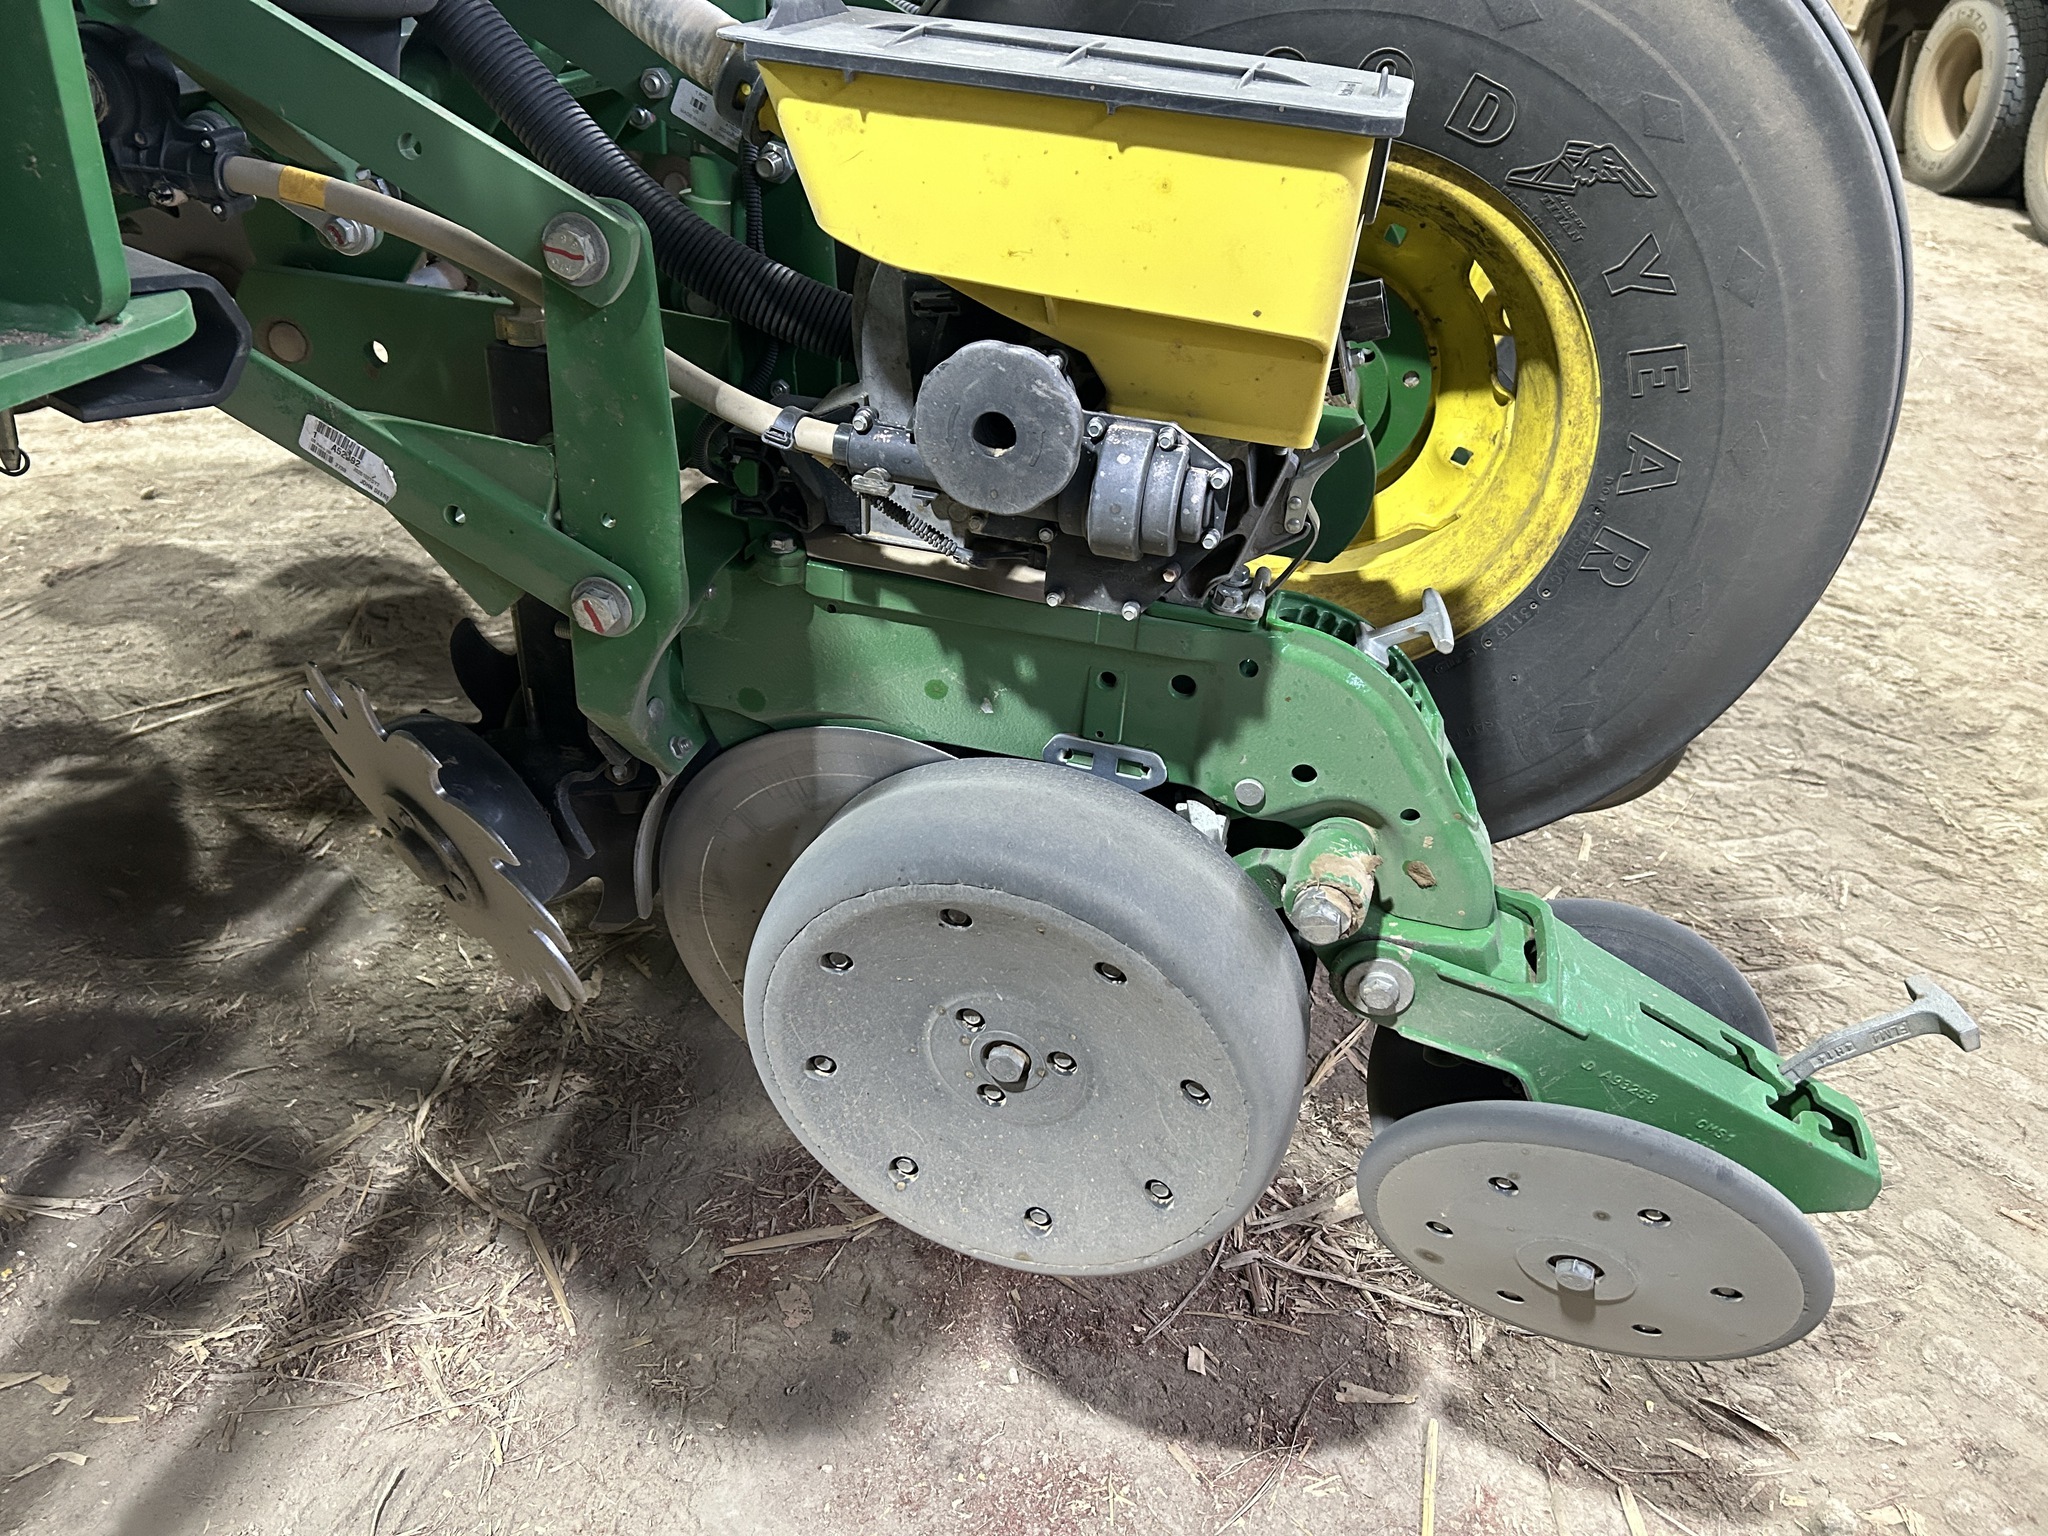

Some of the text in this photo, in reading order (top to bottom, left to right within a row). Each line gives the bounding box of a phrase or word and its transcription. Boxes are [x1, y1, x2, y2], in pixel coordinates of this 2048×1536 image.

[1539, 192, 1585, 242] TITAN
[312, 431, 318, 439] 1
[360, 479, 390, 501] JOHN DEERE
[1496, 607, 1532, 640] 3115
[1599, 1070, 1659, 1104] A93258
